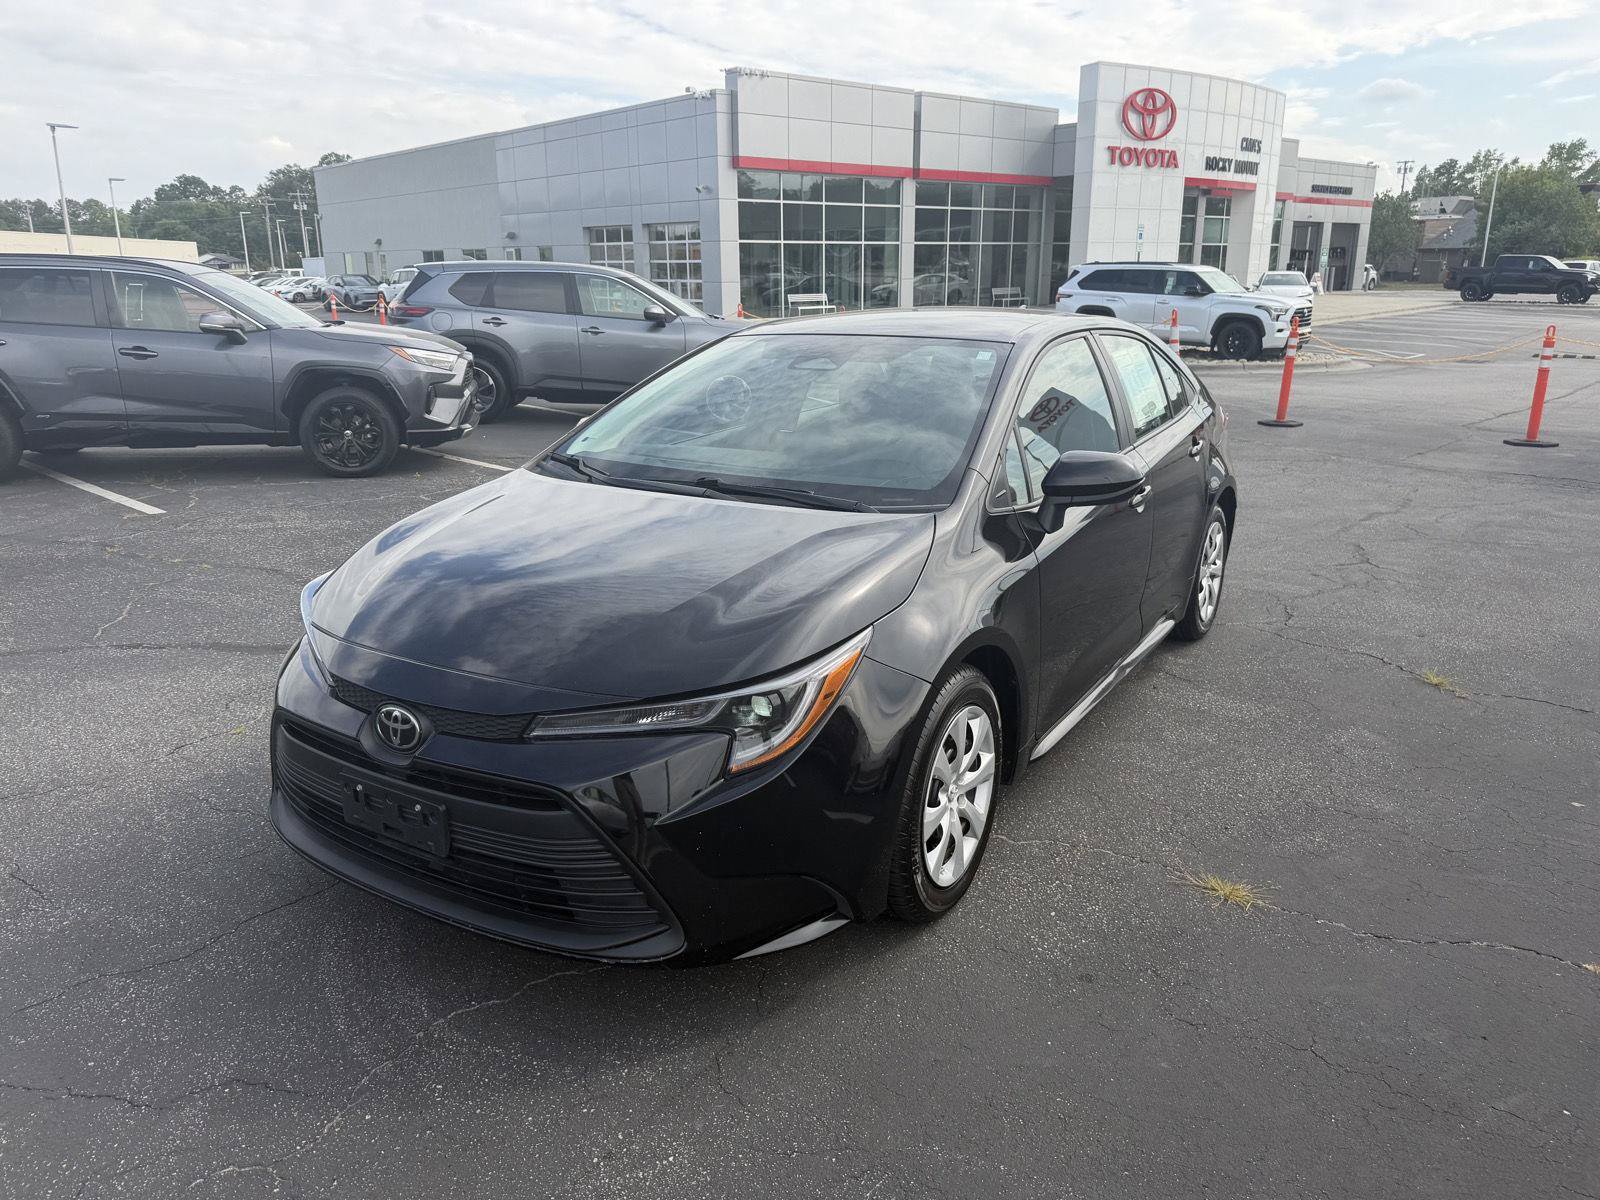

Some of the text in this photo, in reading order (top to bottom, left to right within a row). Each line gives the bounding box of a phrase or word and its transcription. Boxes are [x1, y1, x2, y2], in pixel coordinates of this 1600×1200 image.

[1107, 145, 1179, 168] TOYOTA
[1205, 156, 1260, 176] ROCKY MOUNT
